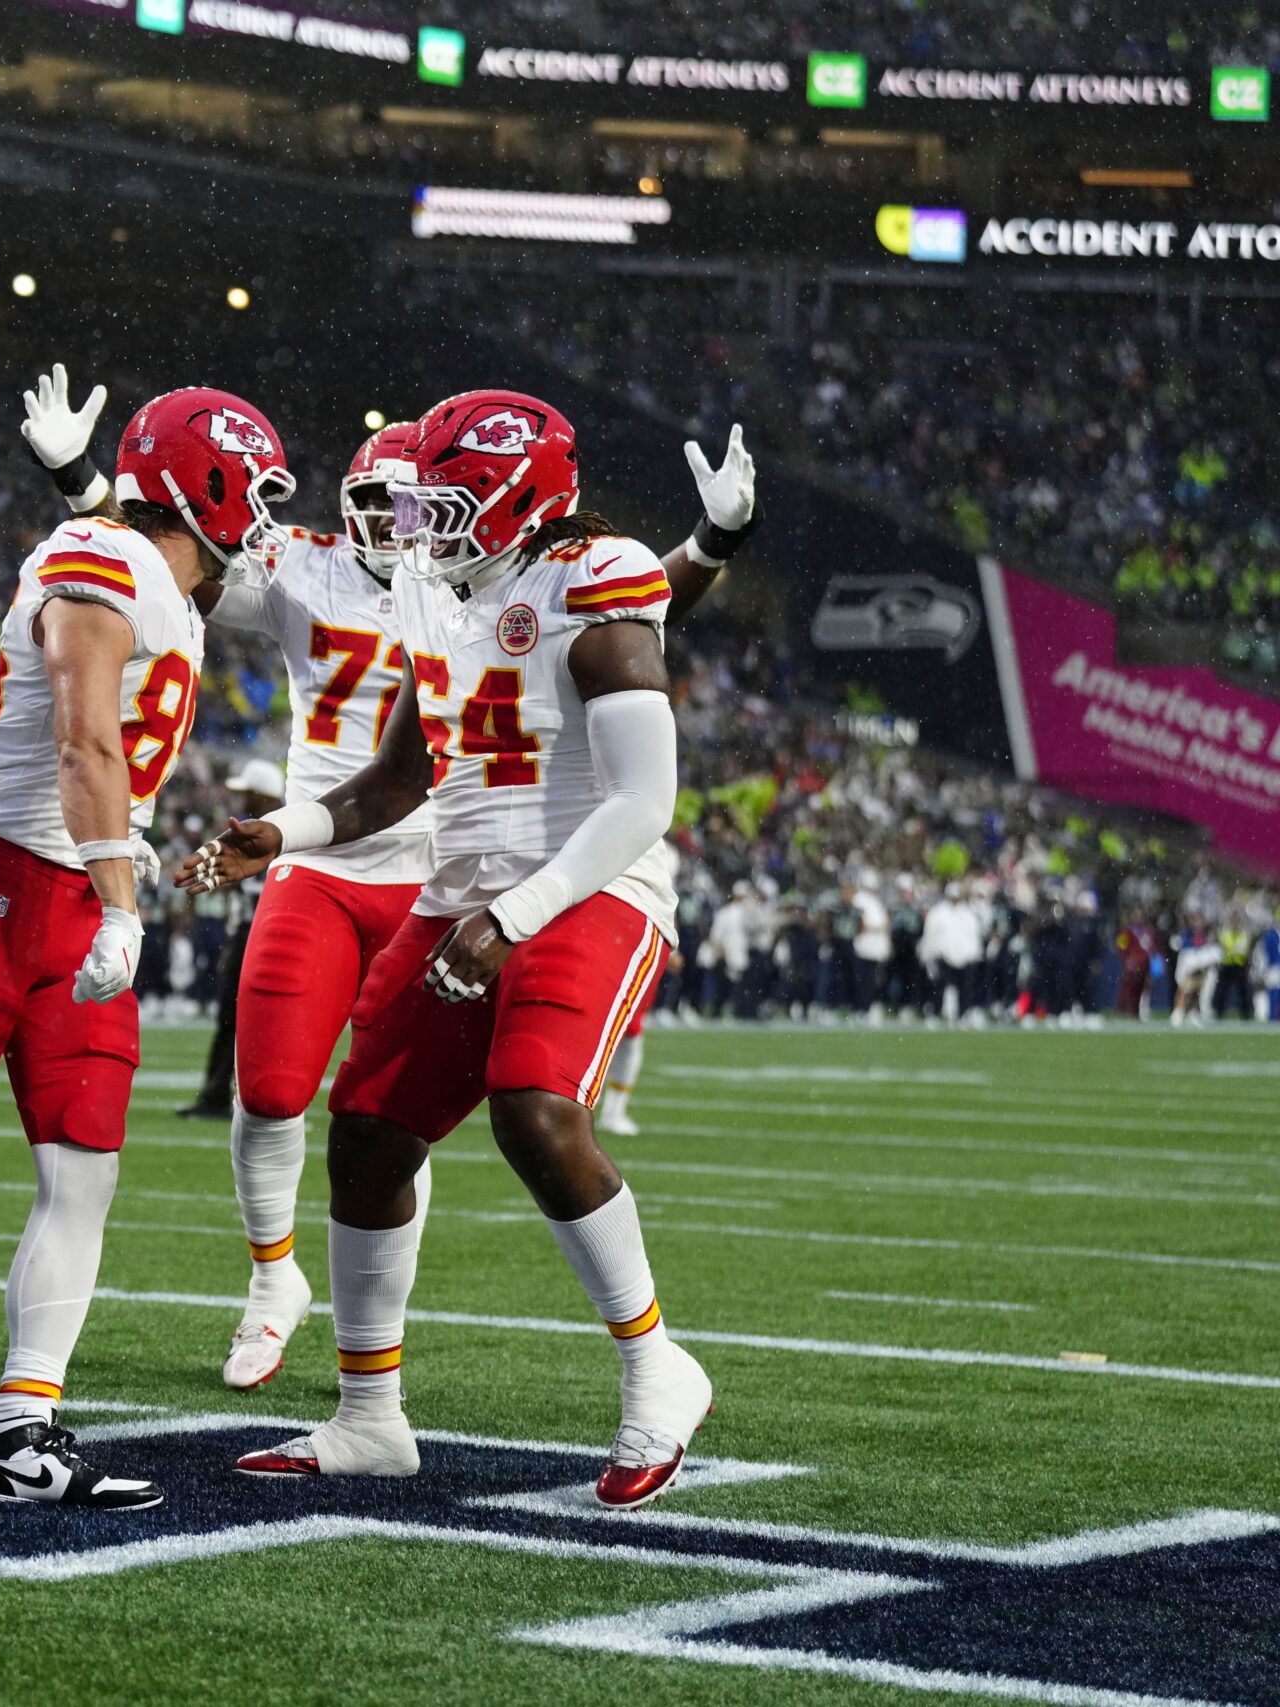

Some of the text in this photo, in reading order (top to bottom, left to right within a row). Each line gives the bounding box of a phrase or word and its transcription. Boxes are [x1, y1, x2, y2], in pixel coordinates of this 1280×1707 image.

[477, 47, 623, 84] ACCIDENT
[626, 56, 789, 92] ATTORNEYS
[879, 67, 1191, 106] ACCIDENT ATTORNEYS
[978, 217, 1280, 260] ACCIDENT ATTO
[1052, 651, 1266, 752] America's
[1082, 703, 1184, 760] Mobile
